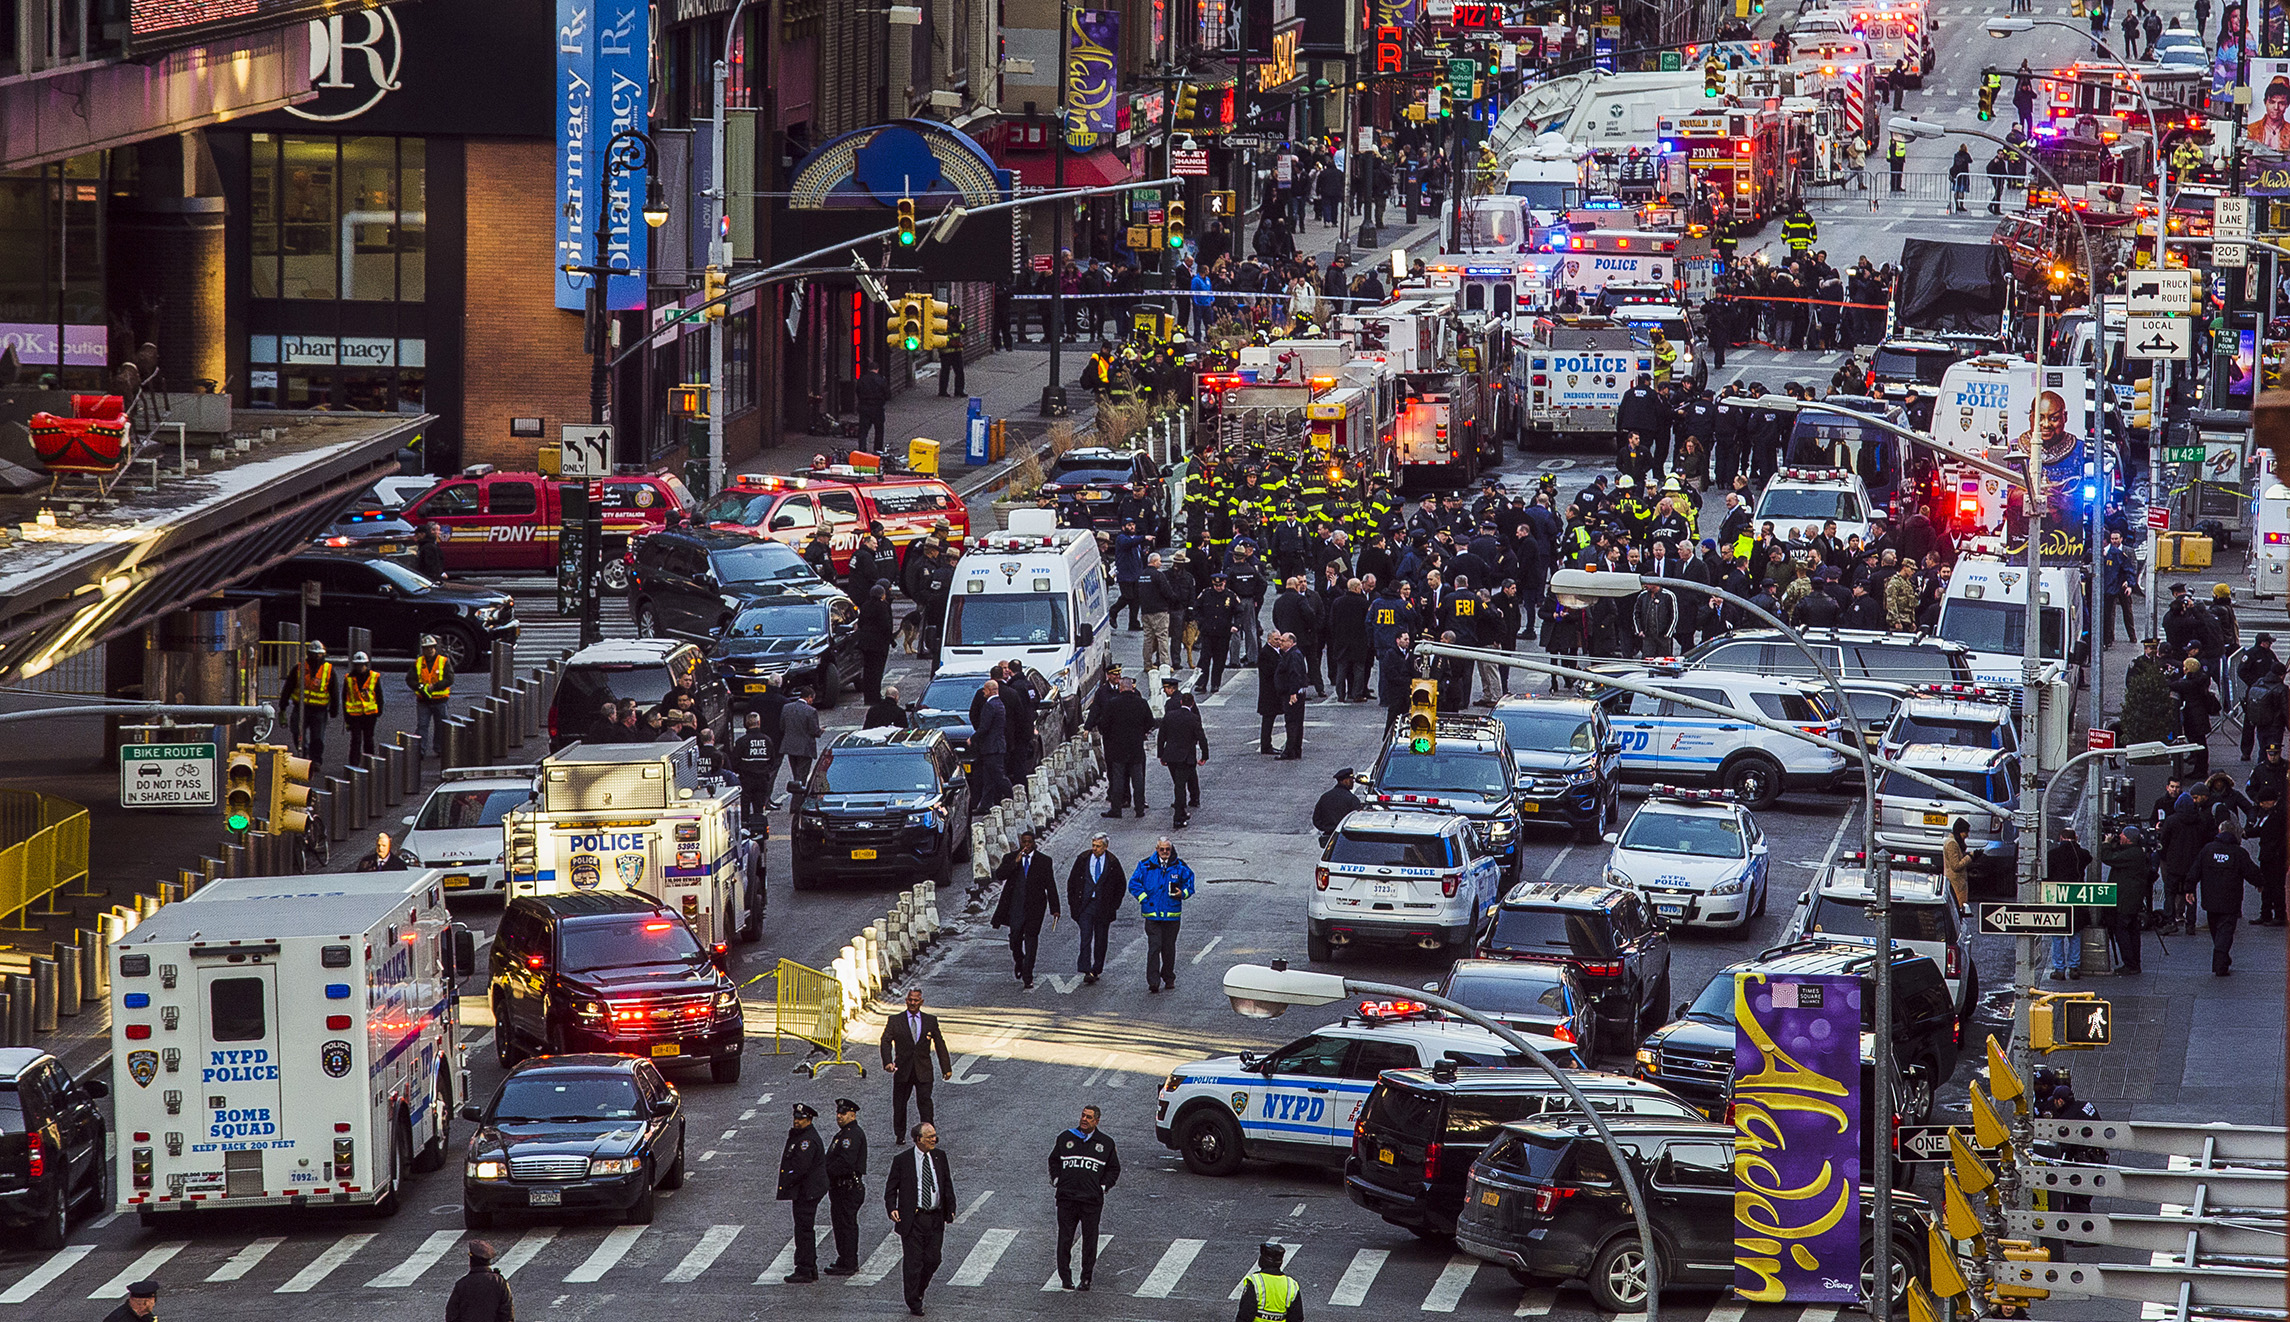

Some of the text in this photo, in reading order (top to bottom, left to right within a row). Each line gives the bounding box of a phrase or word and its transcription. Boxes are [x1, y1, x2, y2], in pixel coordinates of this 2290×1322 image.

[1692, 148, 1719, 158] FDNY
[2222, 202, 2241, 212] BUS
[2219, 215, 2243, 225] LANE
[2215, 246, 2239, 257] $205
[1594, 258, 1638, 271] POLICE
[2162, 280, 2188, 288] TRUCK
[2161, 294, 2188, 303] ROUTE
[2142, 321, 2174, 330] LOCAL
[284, 338, 391, 364] pharmacy
[1554, 358, 1627, 373] POLICE
[1956, 392, 2008, 409] POLIC
[2171, 447, 2204, 461] W 42 ST
[562, 464, 585, 474] ONLY
[489, 525, 536, 542] FDNY
[829, 532, 864, 551] FDNY
[1968, 574, 1988, 583] NYPD
[1455, 600, 1475, 616] FBI
[1376, 609, 1395, 625] FBI
[750, 739, 766, 747] STATE
[133, 747, 204, 758] BIKE ROUTE
[750, 747, 768, 755] POLICE
[136, 779, 202, 790] DO NOT PASS
[128, 791, 210, 802] IN SHARED LANE
[570, 833, 644, 852] POLICE
[618, 856, 642, 865] POLICE
[2213, 853, 2229, 861] NYPD
[1339, 865, 1435, 876] NYPD POLICE
[1654, 879, 1690, 887] POLICE
[1373, 885, 1391, 893] 3723
[2057, 886, 2110, 903] W 41 ST
[1659, 905, 1677, 913] 4370
[1995, 913, 2061, 926] ONE WAY
[322, 1041, 350, 1053] POLICE
[210, 1049, 269, 1065] NYPD
[202, 1065, 279, 1083] POLICE
[1193, 1076, 1219, 1084] POLICE
[1262, 1092, 1325, 1122] NYPD
[214, 1108, 271, 1123] BOMB
[210, 1122, 276, 1139] SQUAD
[192, 1140, 296, 1153] KEEP BACK 200 FEET
[1915, 1137, 1945, 1150] ONE
[1062, 1159, 1099, 1172] POLICE
[291, 1173, 312, 1182] 7092
[1821, 1278, 1854, 1292] Disney
